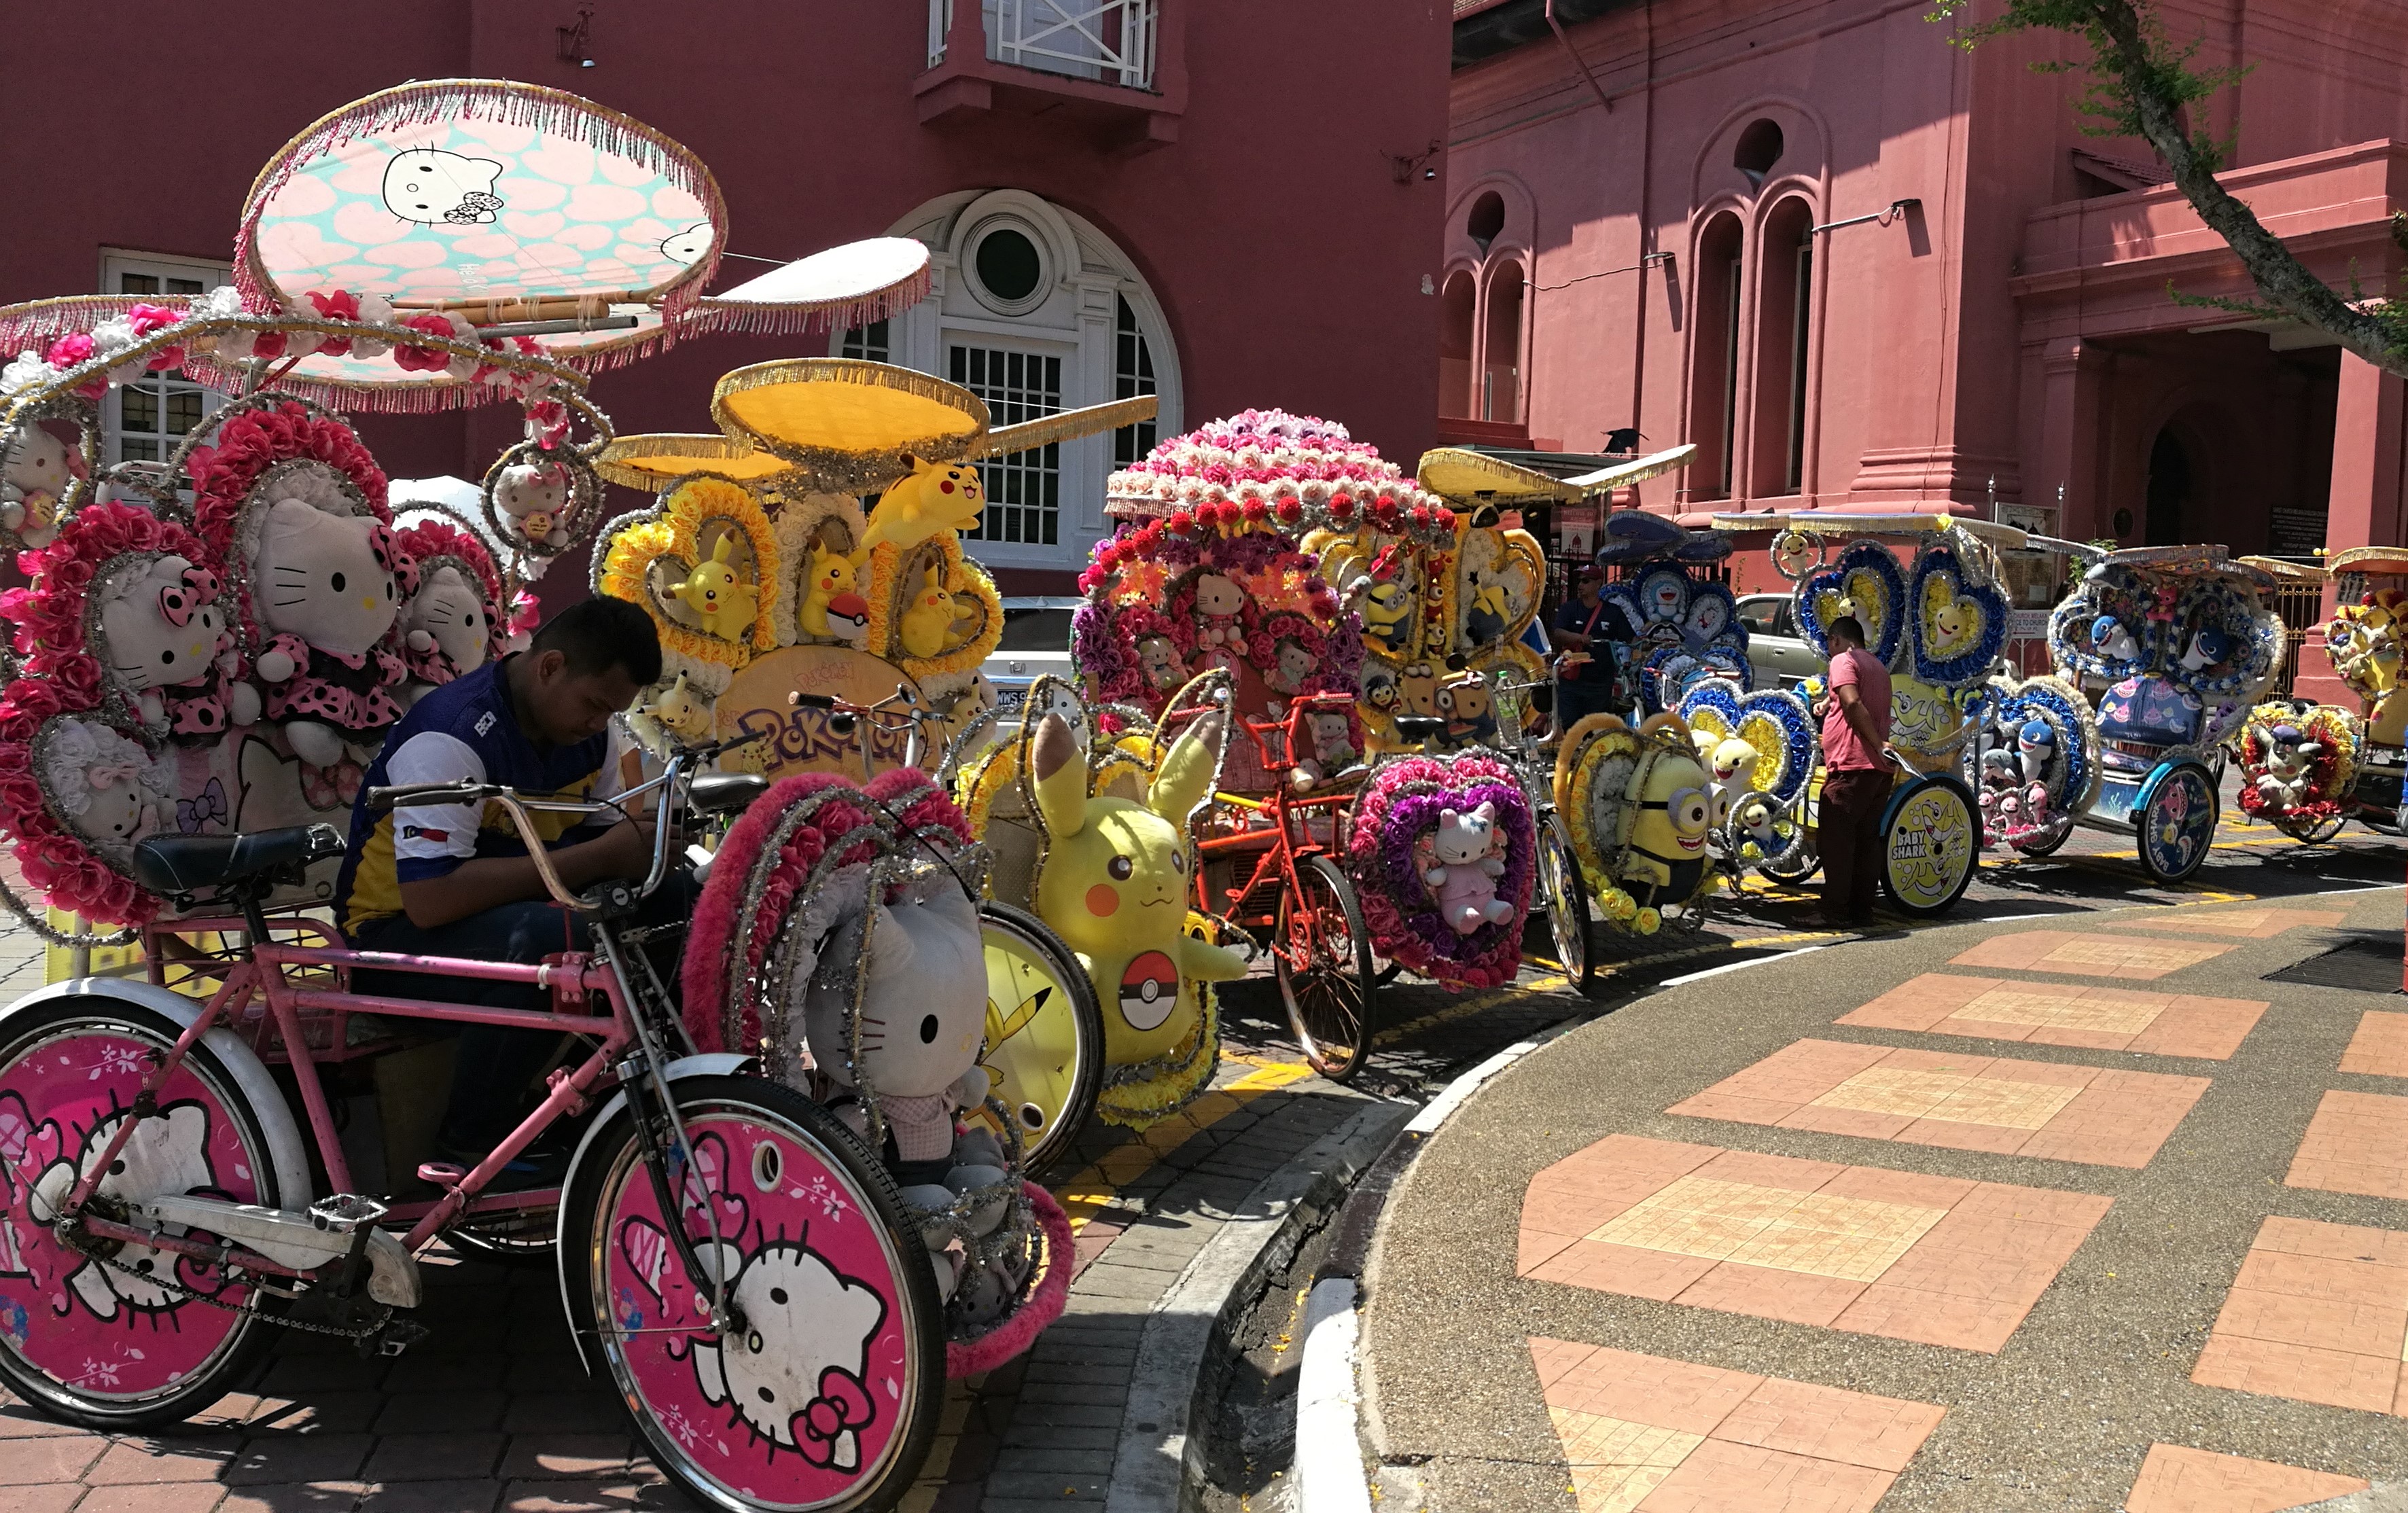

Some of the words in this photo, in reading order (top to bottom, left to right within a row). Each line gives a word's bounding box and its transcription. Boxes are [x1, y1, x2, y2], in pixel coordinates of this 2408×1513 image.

[474, 711, 497, 737] BECA
[2150, 802, 2161, 844] SHARK
[1898, 830, 1925, 847] BABY
[1892, 844, 1926, 860] SHARK
[2152, 847, 2170, 872] BABY
